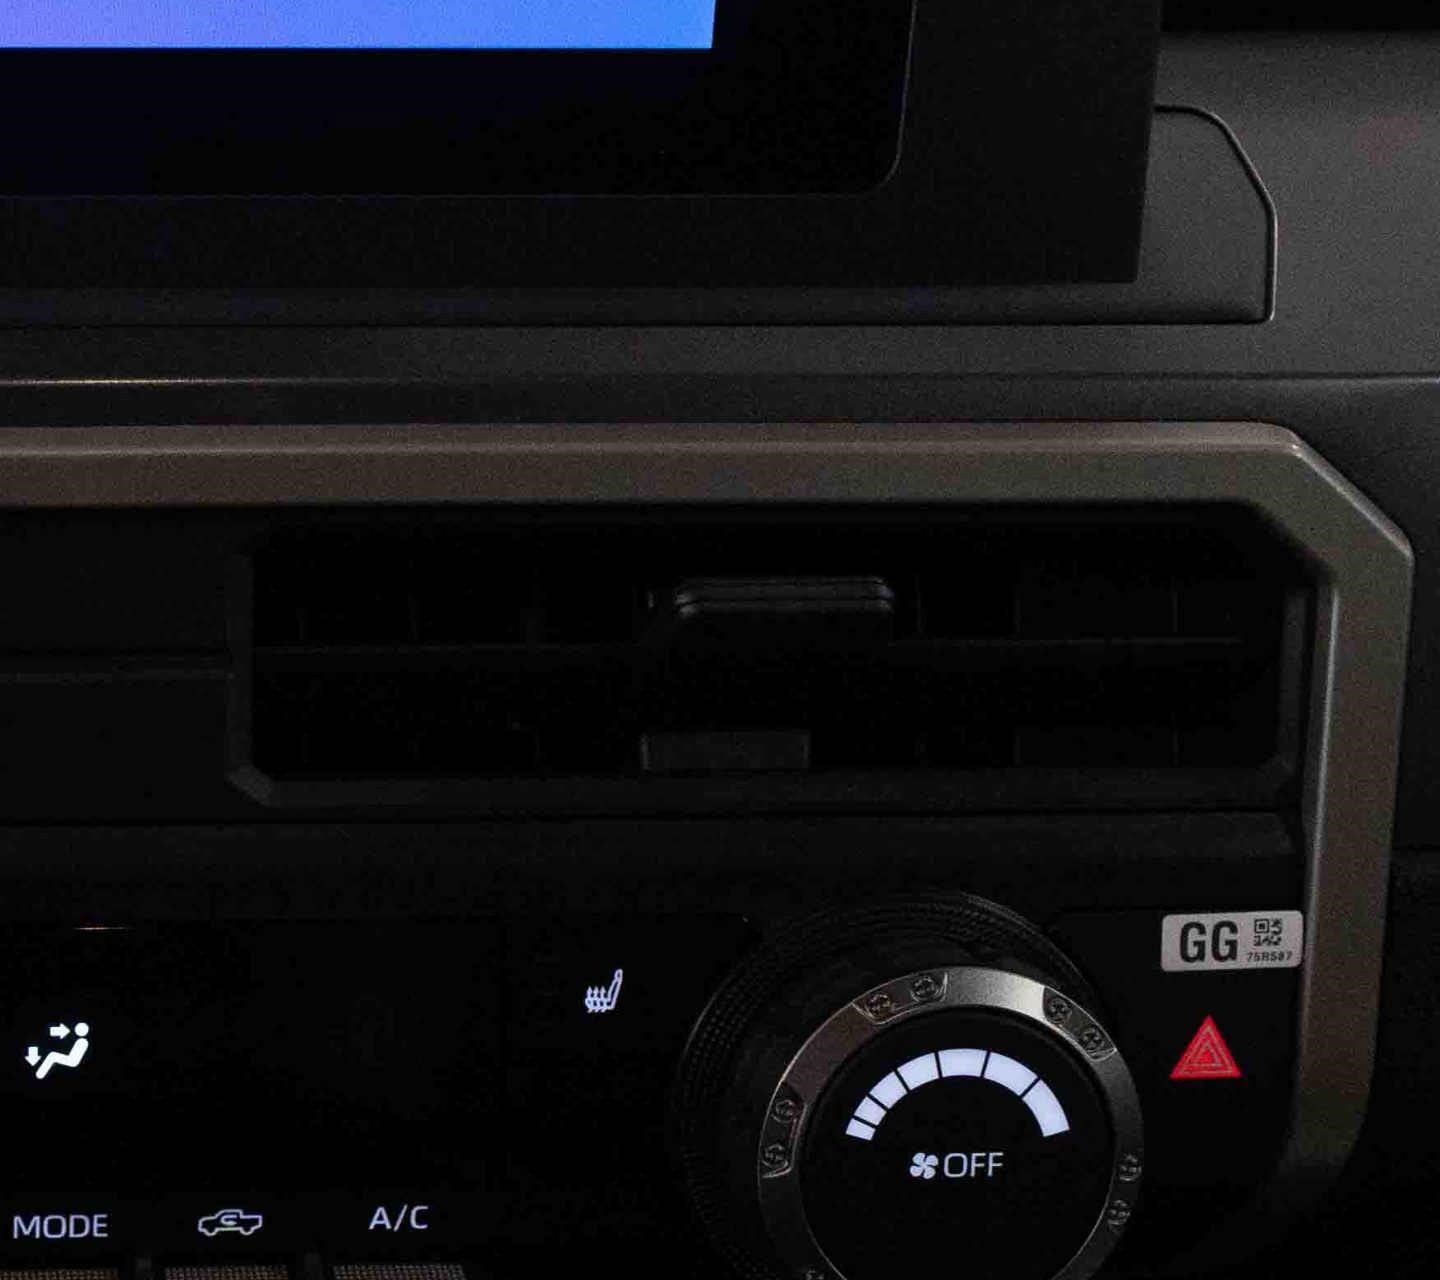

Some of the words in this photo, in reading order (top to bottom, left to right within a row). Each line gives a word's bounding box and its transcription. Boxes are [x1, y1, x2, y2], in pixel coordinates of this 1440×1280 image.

[1180, 919, 1239, 963] GG
[942, 1151, 1005, 1179] OFF
[12, 1213, 109, 1239] MODE
[368, 1203, 431, 1232] A/C
